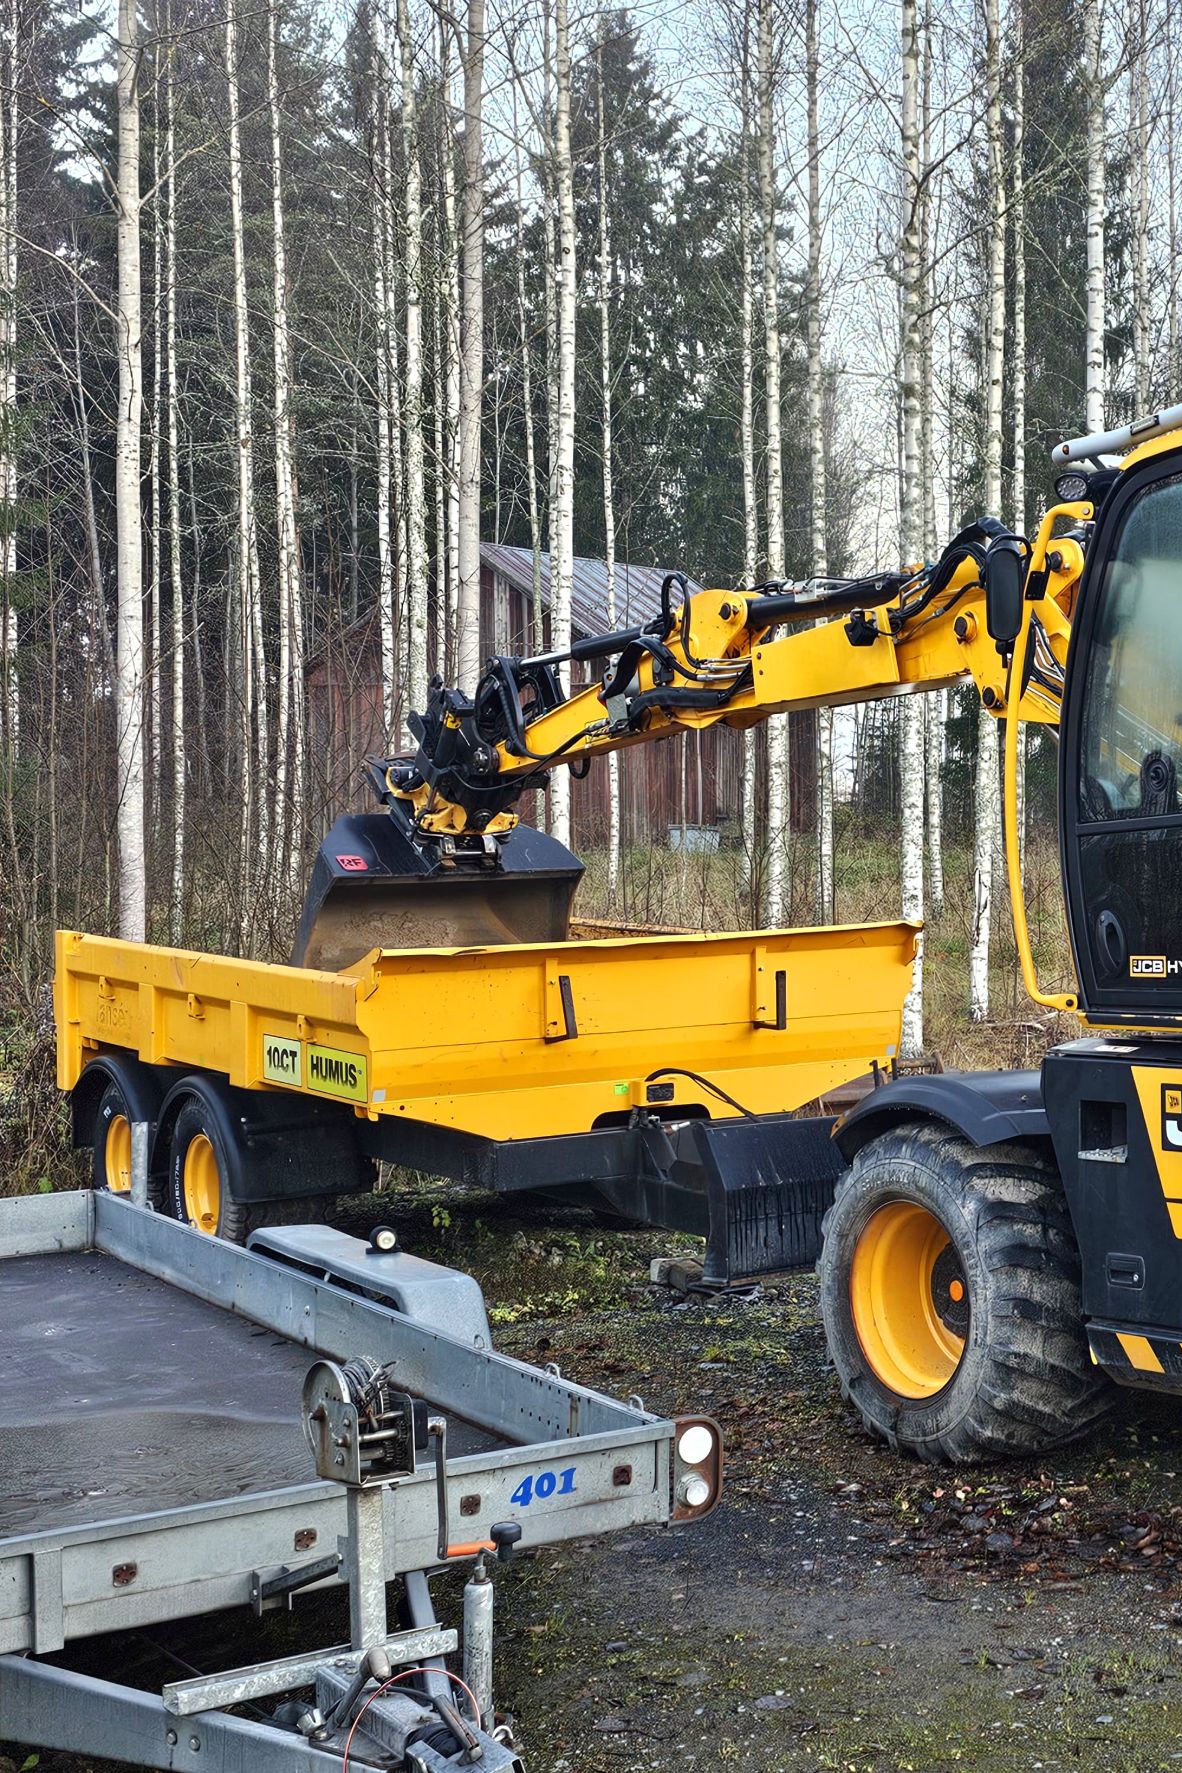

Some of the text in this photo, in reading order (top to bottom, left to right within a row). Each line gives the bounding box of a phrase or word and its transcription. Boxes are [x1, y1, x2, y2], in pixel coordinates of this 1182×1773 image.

[1132, 960, 1163, 972] JCB
[310, 1054, 358, 1089] HUMUS
[510, 1467, 577, 1507] 401
